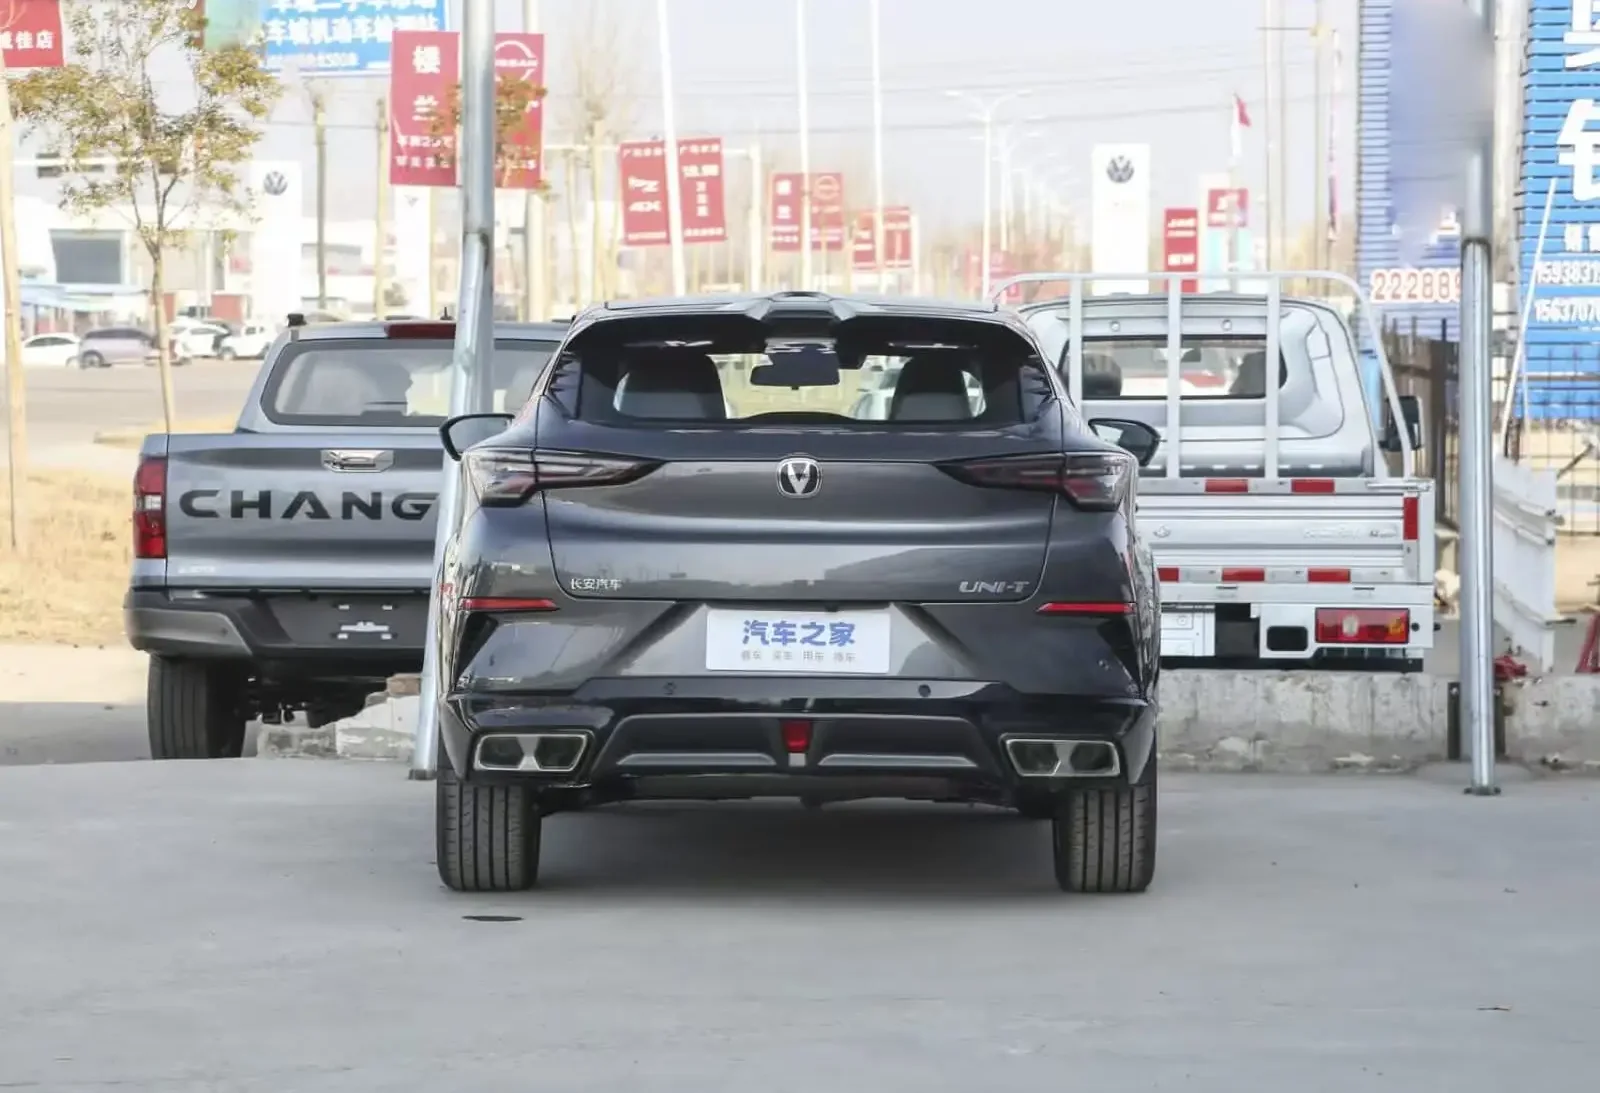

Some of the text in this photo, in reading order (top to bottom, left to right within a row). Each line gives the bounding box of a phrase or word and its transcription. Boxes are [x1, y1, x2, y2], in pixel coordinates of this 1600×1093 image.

[178, 489, 440, 521] CHANG
[570, 578, 622, 591] 长安汽车
[959, 581, 1030, 593] UNI-T
[742, 619, 857, 648] 汽车之家
